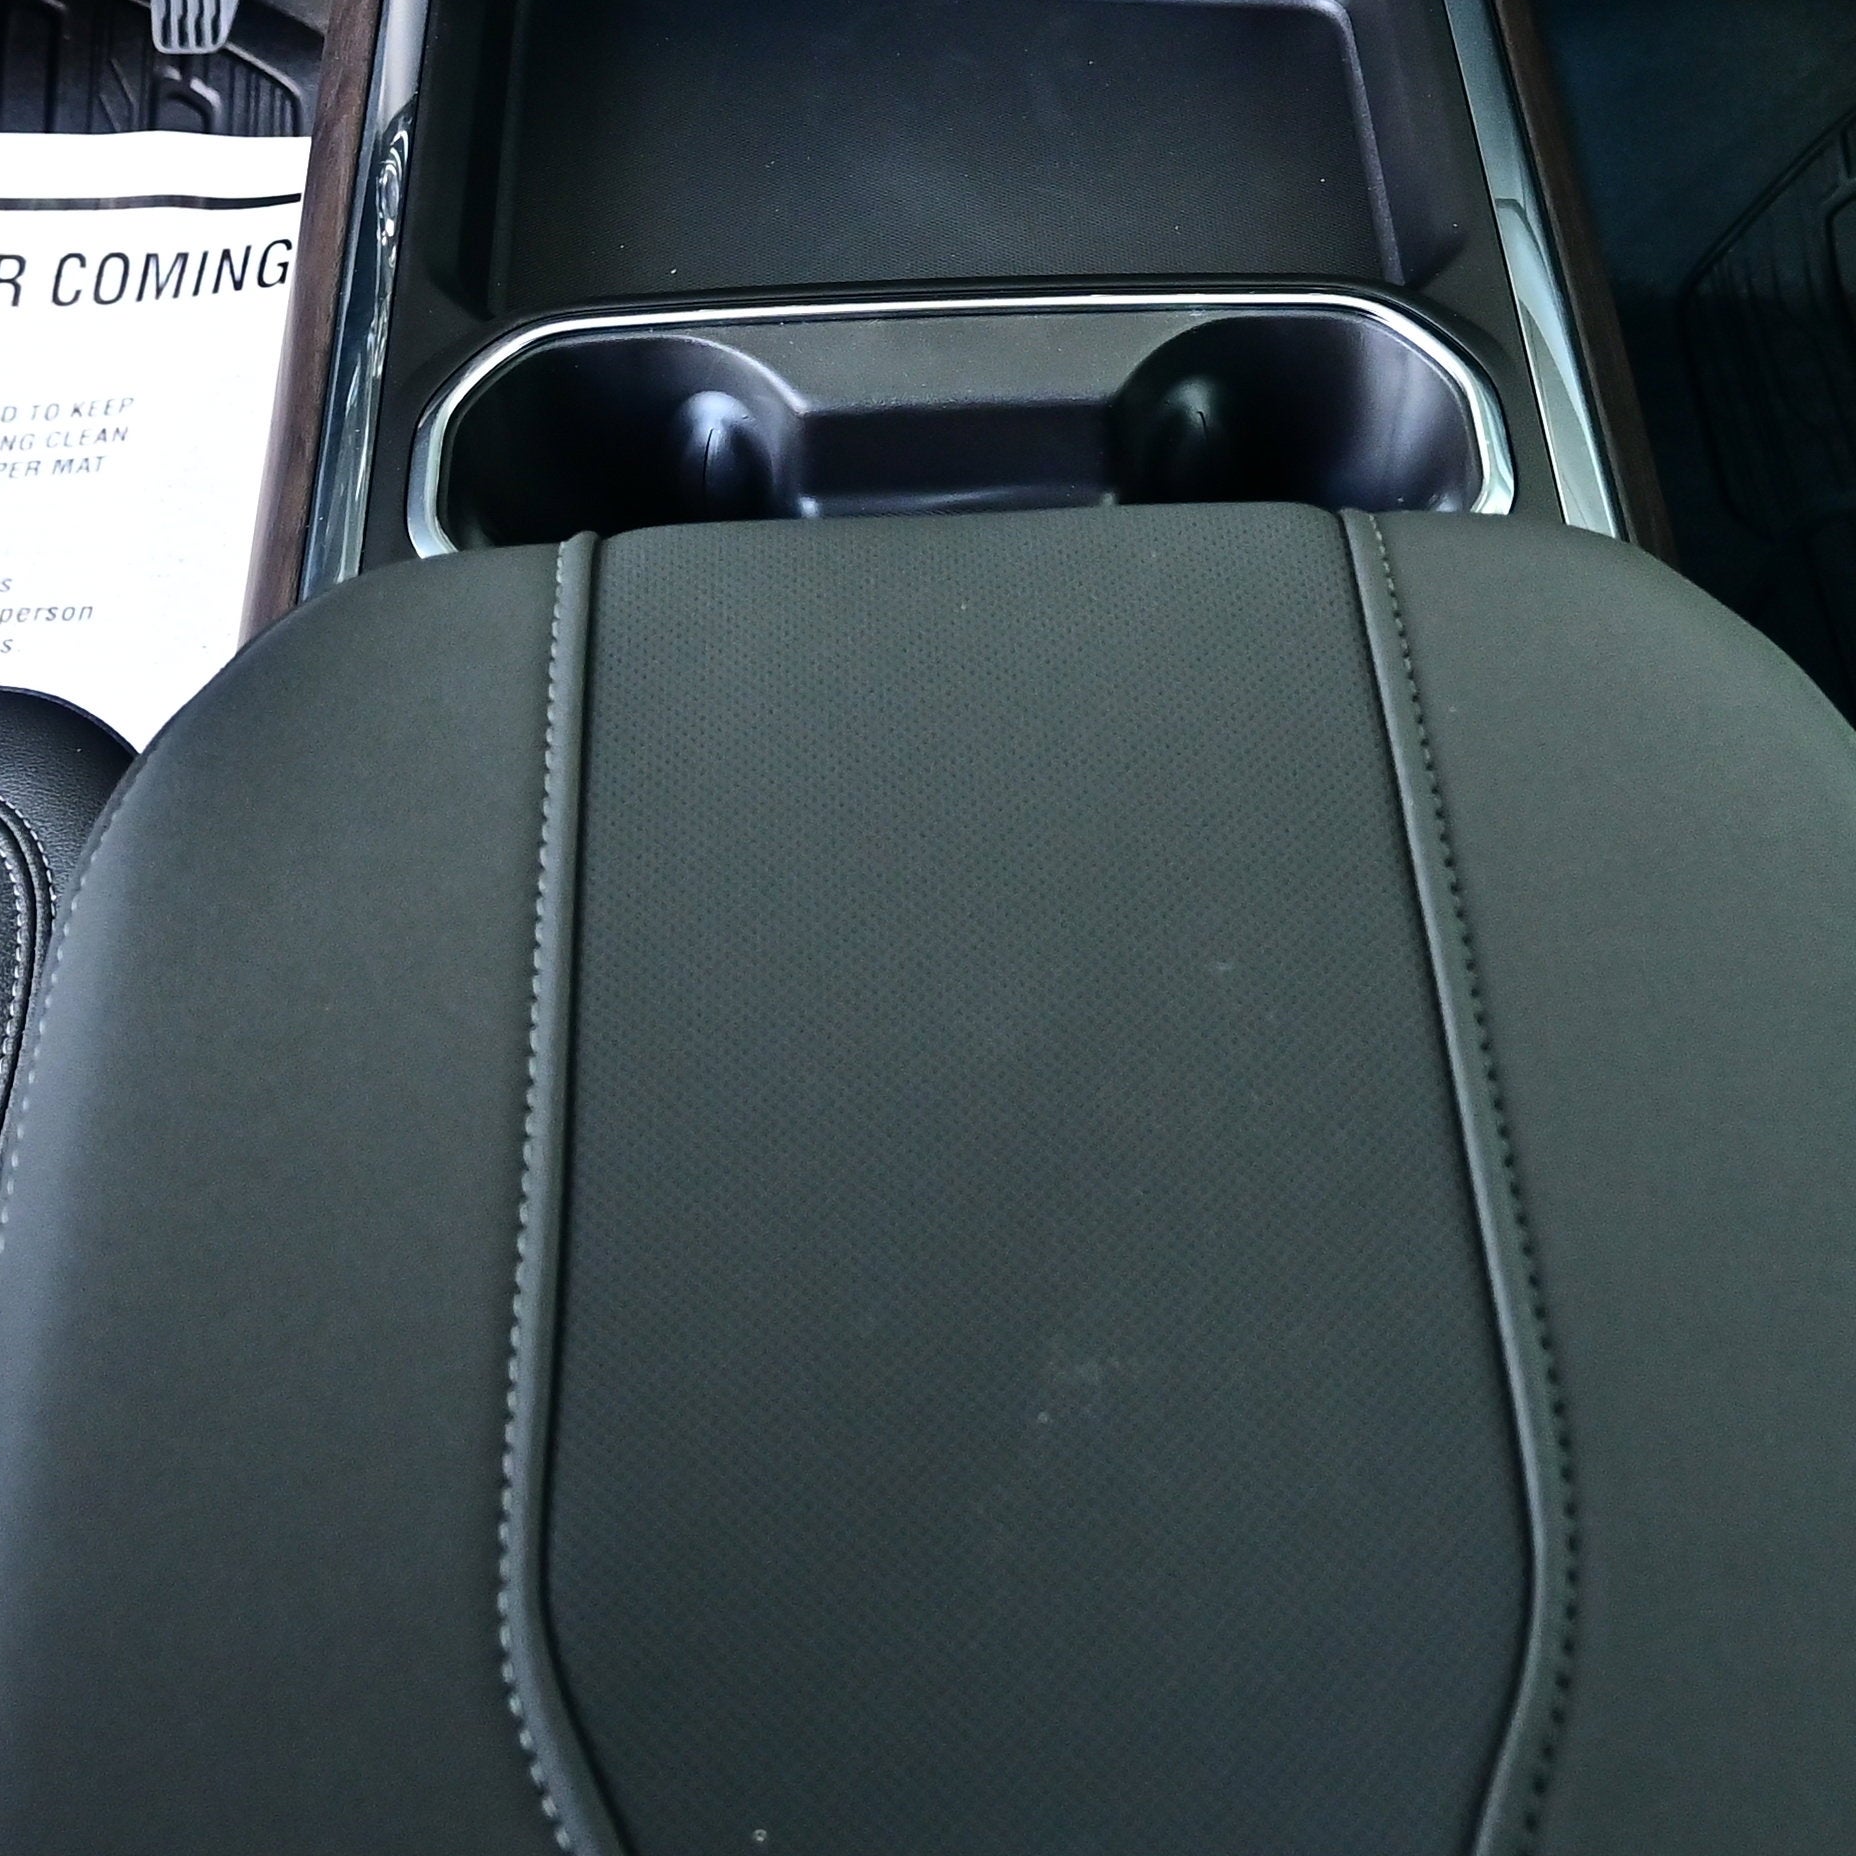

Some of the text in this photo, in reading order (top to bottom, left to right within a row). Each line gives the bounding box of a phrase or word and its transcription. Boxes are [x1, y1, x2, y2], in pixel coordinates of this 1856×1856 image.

[51, 238, 294, 307] COMING
[30, 403, 61, 422] TO
[69, 397, 136, 419] KEEP
[45, 426, 130, 450] CLEAN
[51, 455, 108, 477] MAT
